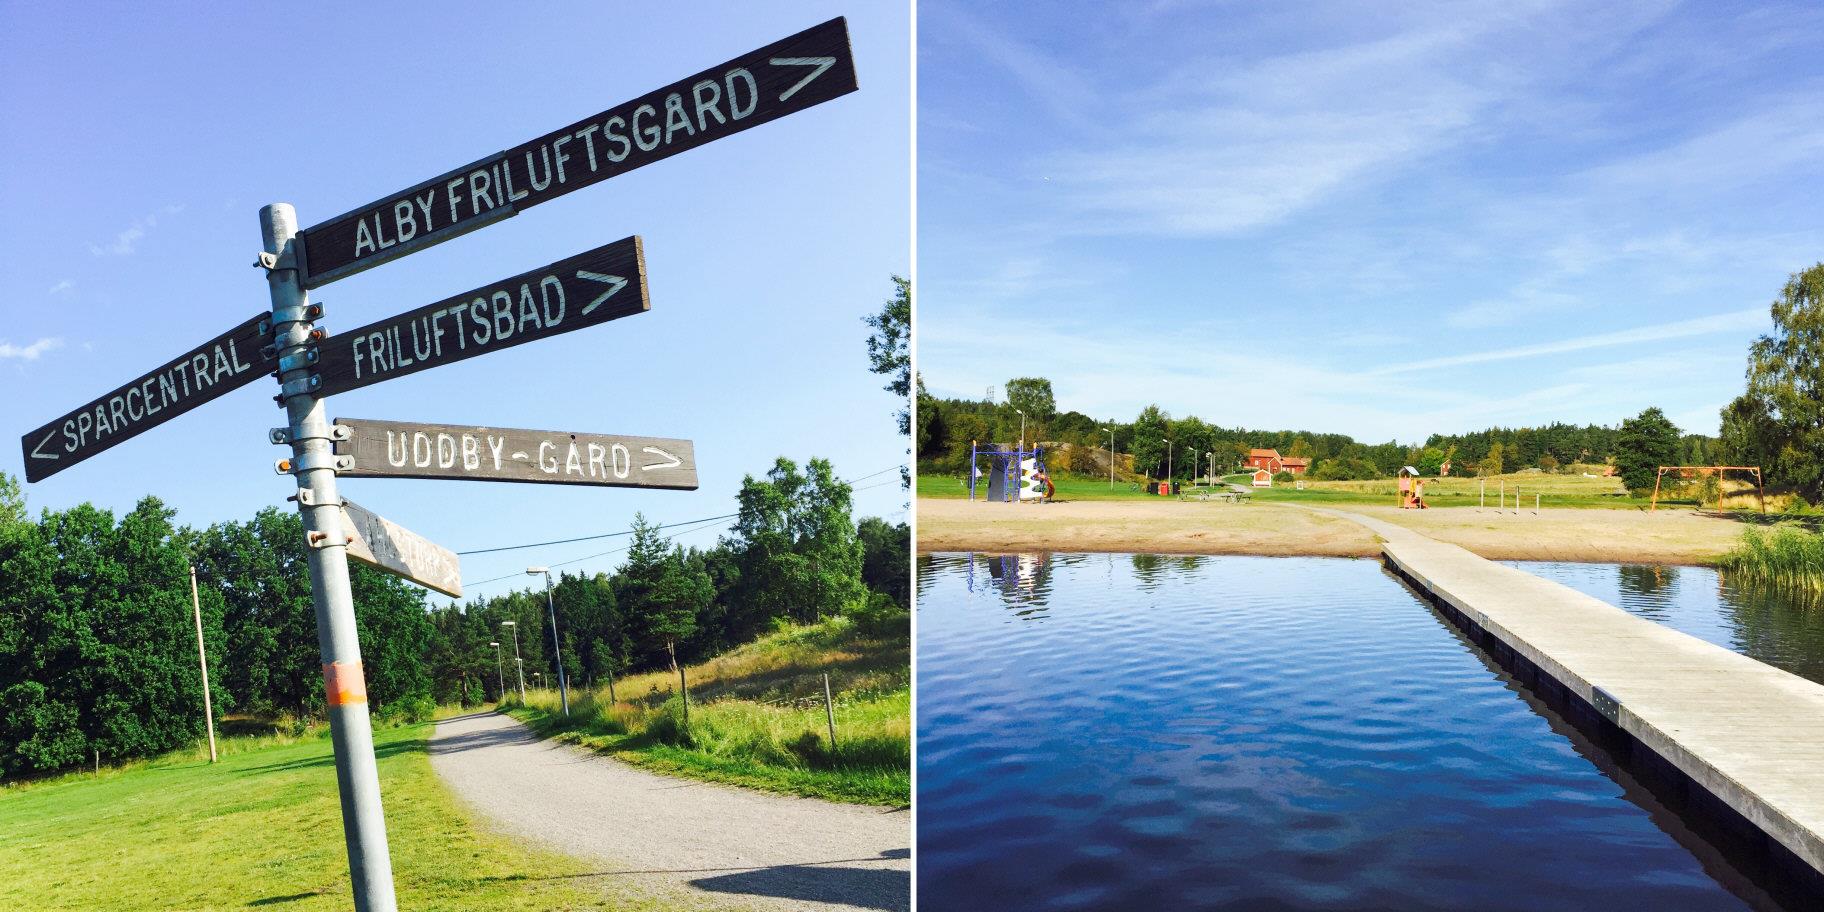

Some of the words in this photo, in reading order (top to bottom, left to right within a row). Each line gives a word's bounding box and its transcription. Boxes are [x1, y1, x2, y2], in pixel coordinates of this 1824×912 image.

[355, 188, 435, 258] ALBY
[447, 66, 758, 223] FRILUFTSGÅRD
[352, 275, 566, 379] FRILUFTSBAD
[63, 338, 251, 453] SPÅRCENTRAL
